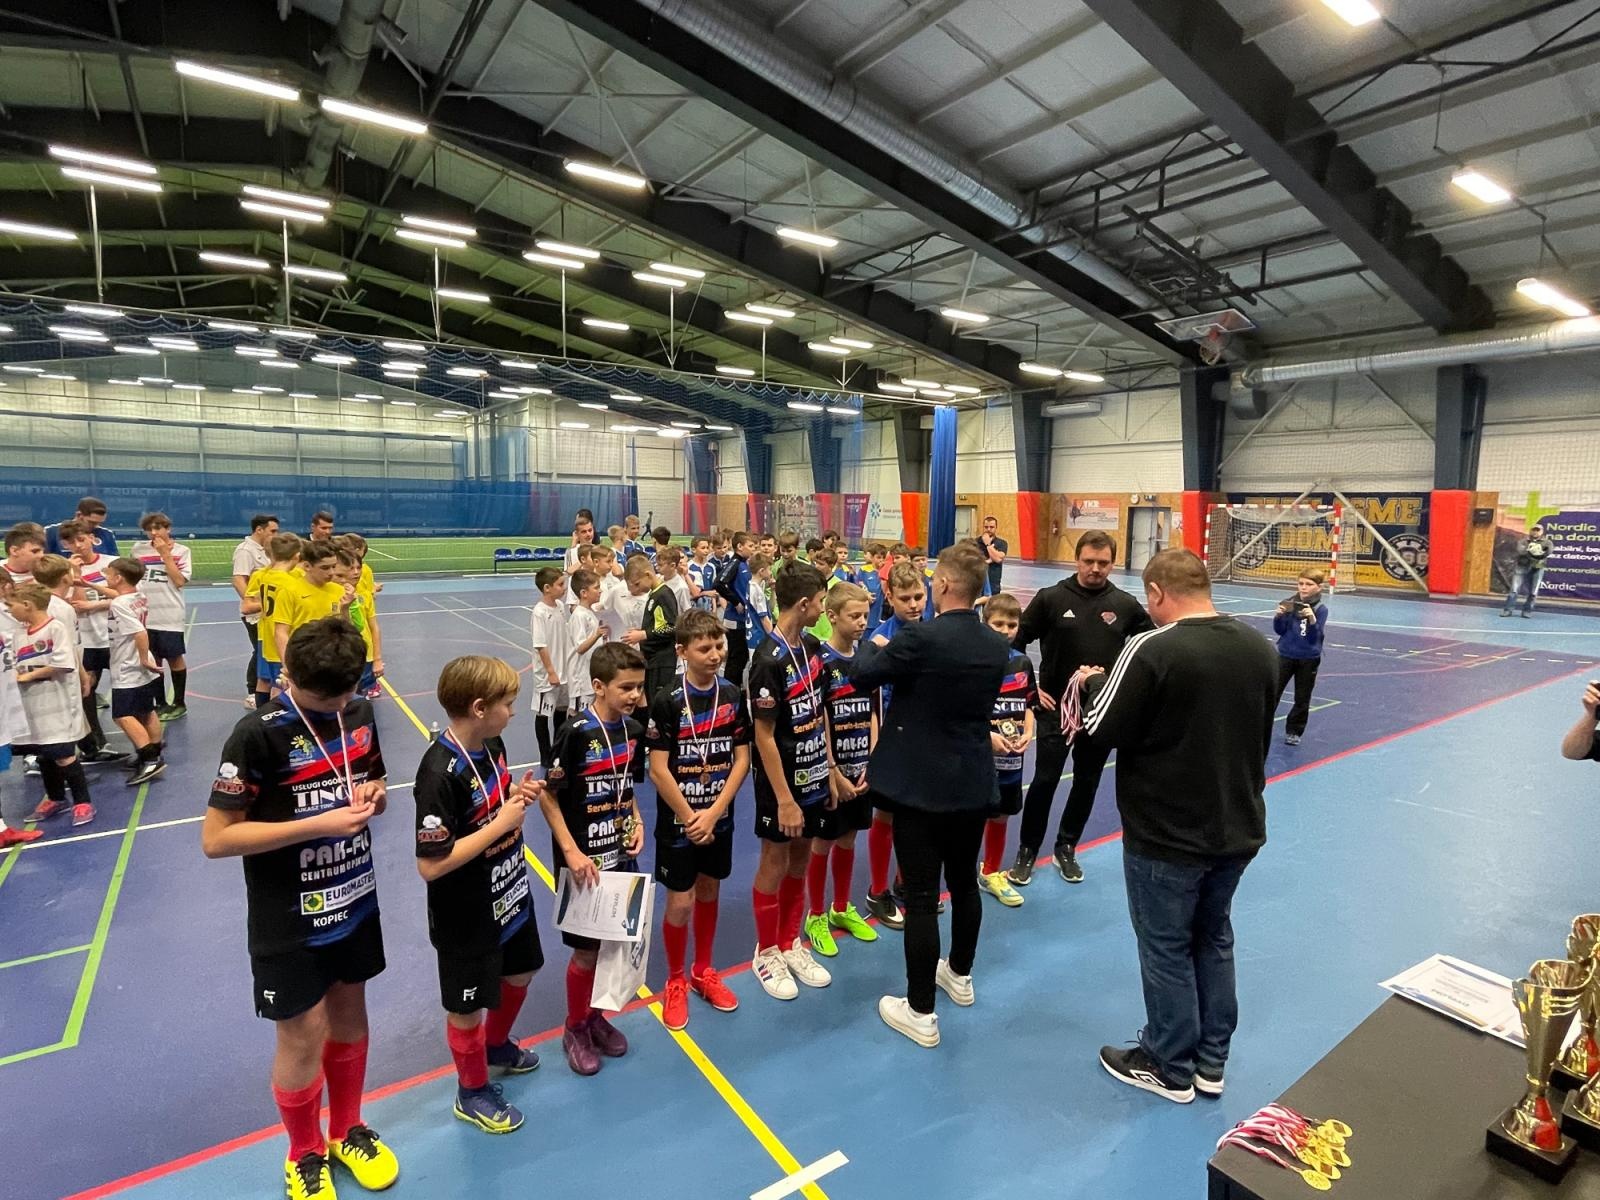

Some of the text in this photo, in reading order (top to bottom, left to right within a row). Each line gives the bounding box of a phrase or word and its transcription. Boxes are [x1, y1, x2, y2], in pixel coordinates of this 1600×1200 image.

[1546, 523, 1597, 532] Nordic
[1562, 553, 1600, 562] datový
[292, 780, 320, 792] USŁUGI
[679, 779, 726, 797] PAK-FO
[301, 862, 346, 882] CENTRUM
[325, 873, 376, 902] EUROMASTE
[313, 910, 349, 928] KOPIEC
